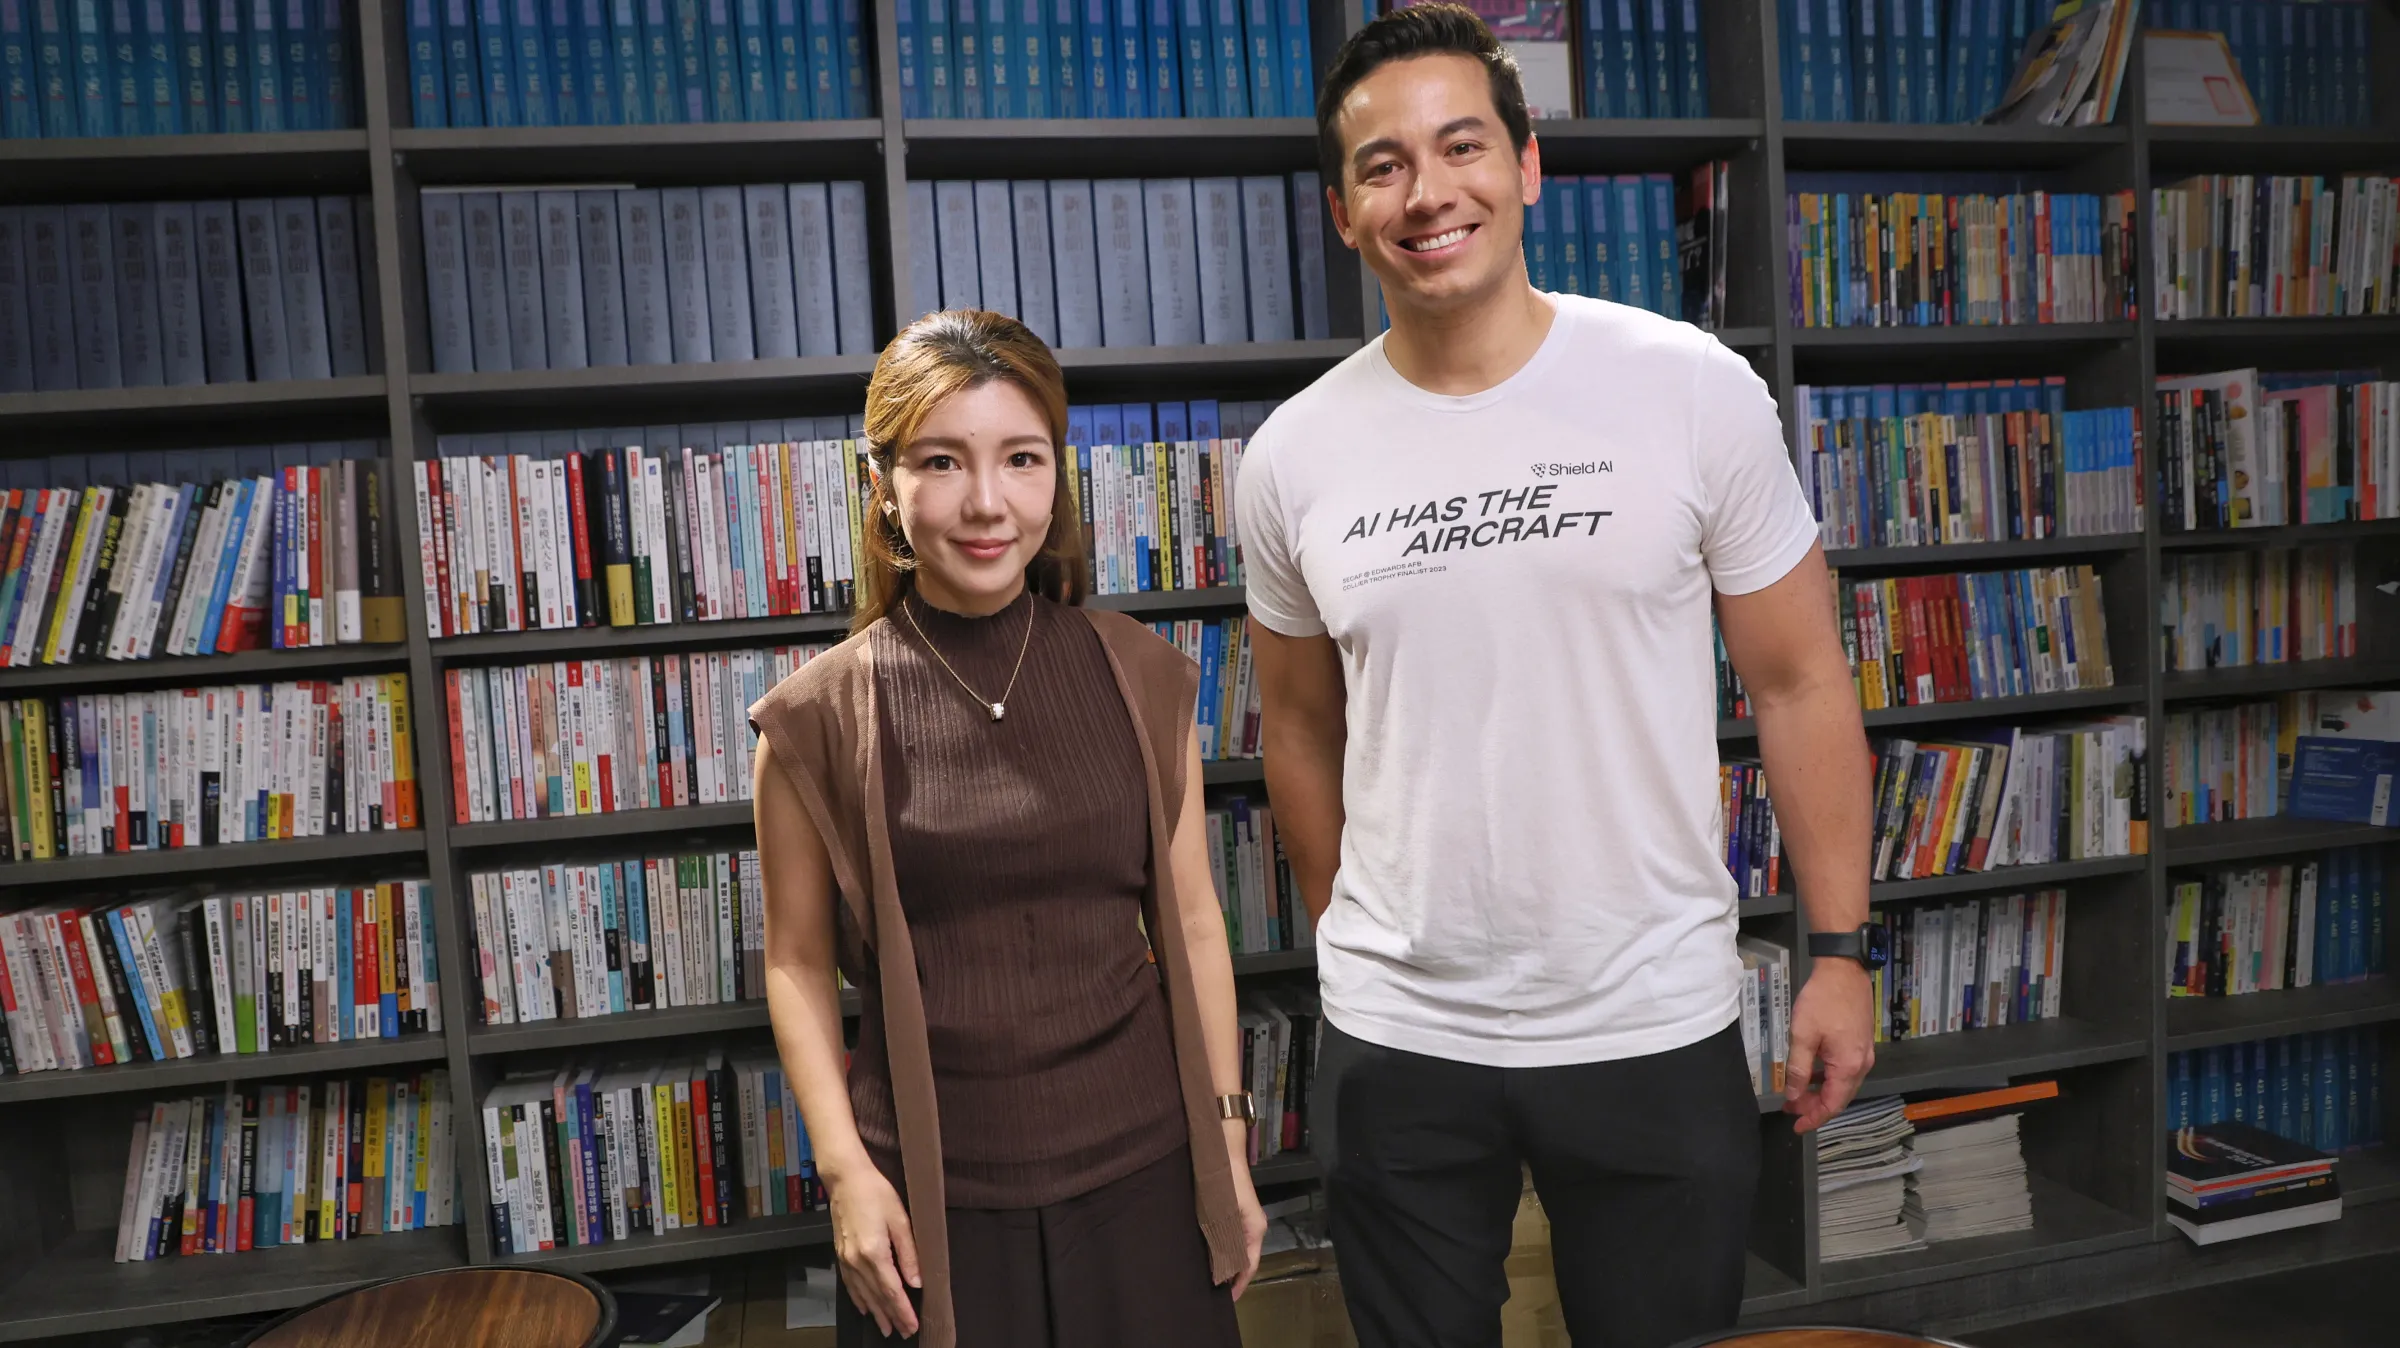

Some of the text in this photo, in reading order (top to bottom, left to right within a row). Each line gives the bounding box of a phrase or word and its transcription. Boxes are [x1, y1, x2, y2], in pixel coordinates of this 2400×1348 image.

[1549, 460, 1613, 476] Shield AI
[1342, 484, 1558, 543] AI HAS THE
[1401, 511, 1612, 557] AIRCRAFT
[1342, 572, 1363, 584] SECAF
[1371, 563, 1406, 576] EDWARDS
[1342, 565, 1447, 591] COLLIER TROPHY FINALIST 2023
